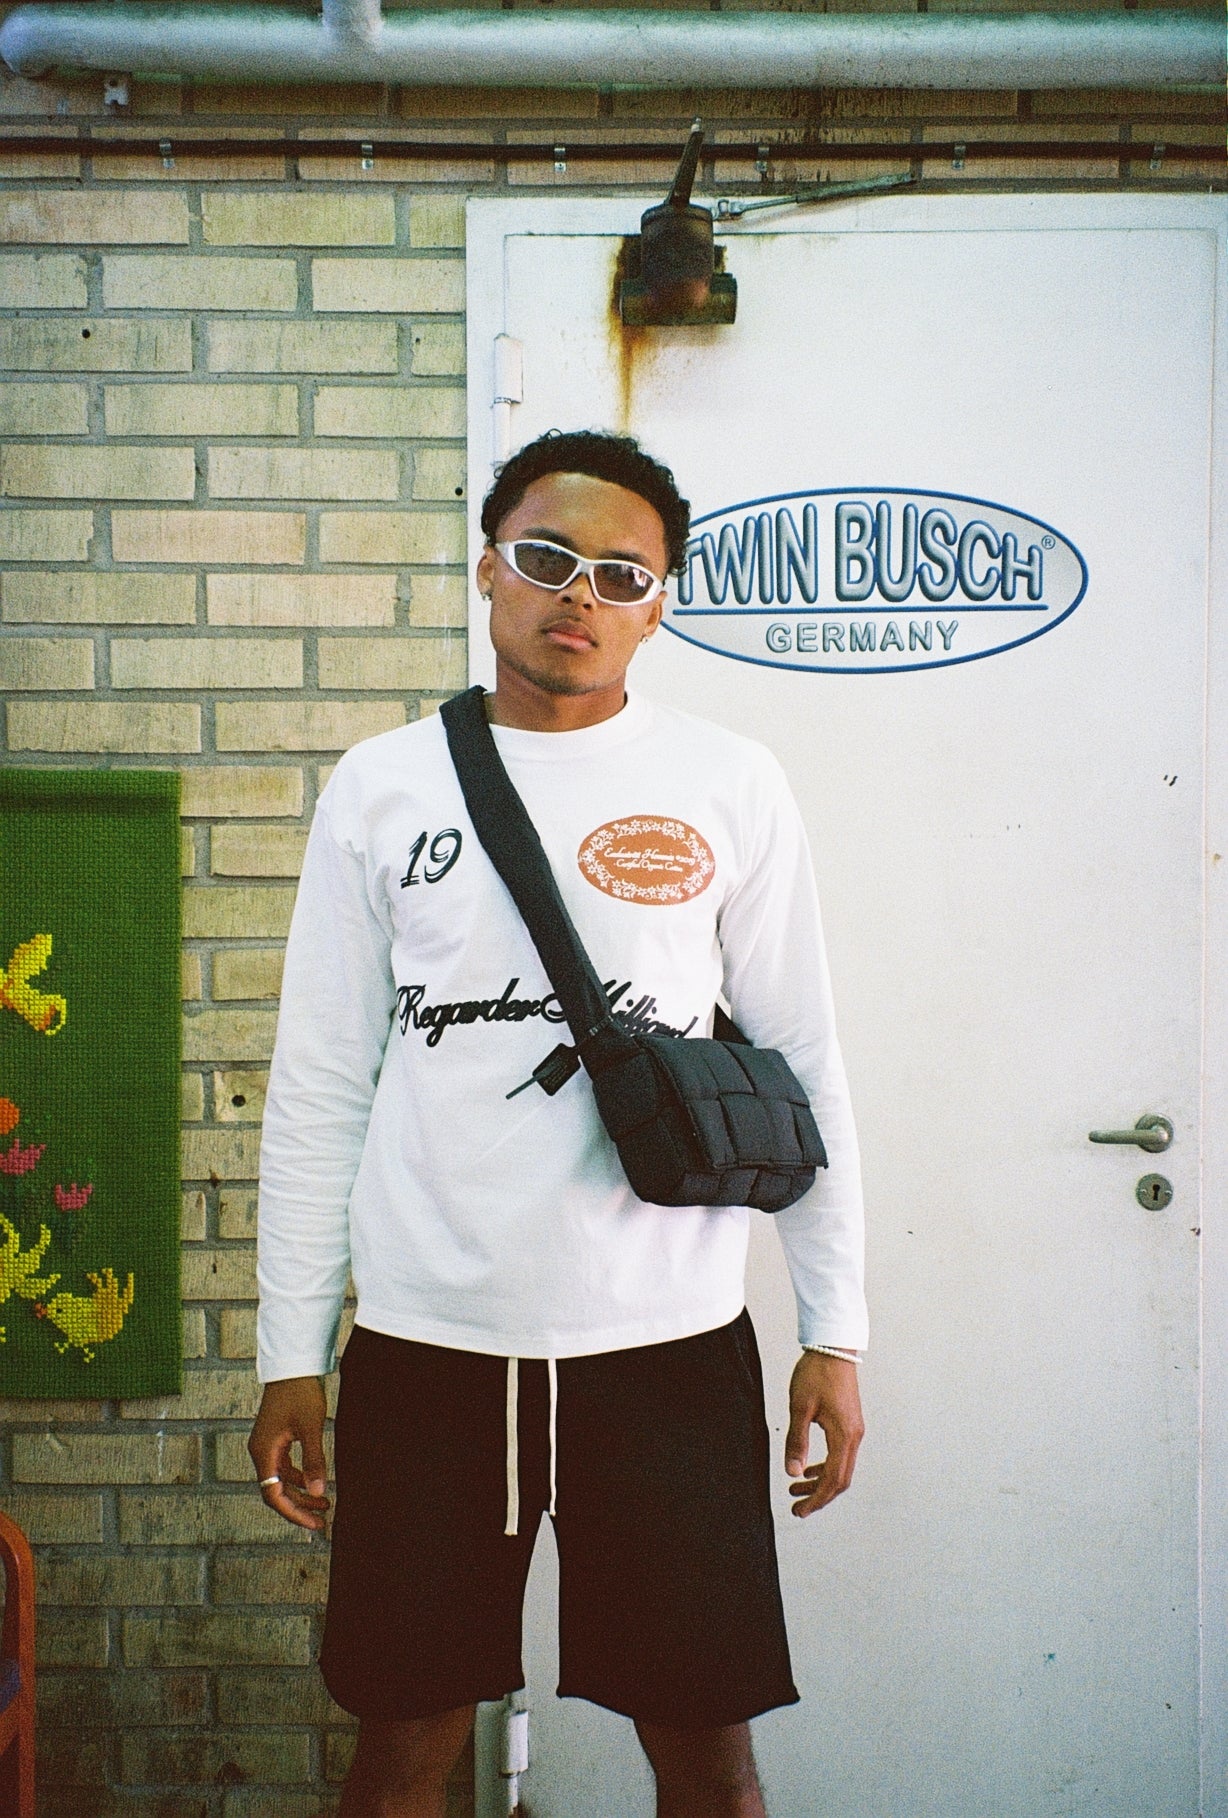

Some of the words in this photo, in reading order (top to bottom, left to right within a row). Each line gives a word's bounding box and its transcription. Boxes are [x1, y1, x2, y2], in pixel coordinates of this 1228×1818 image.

[676, 501, 818, 606] TWIN
[765, 618, 960, 653] GERMANY
[399, 827, 463, 890] 19
